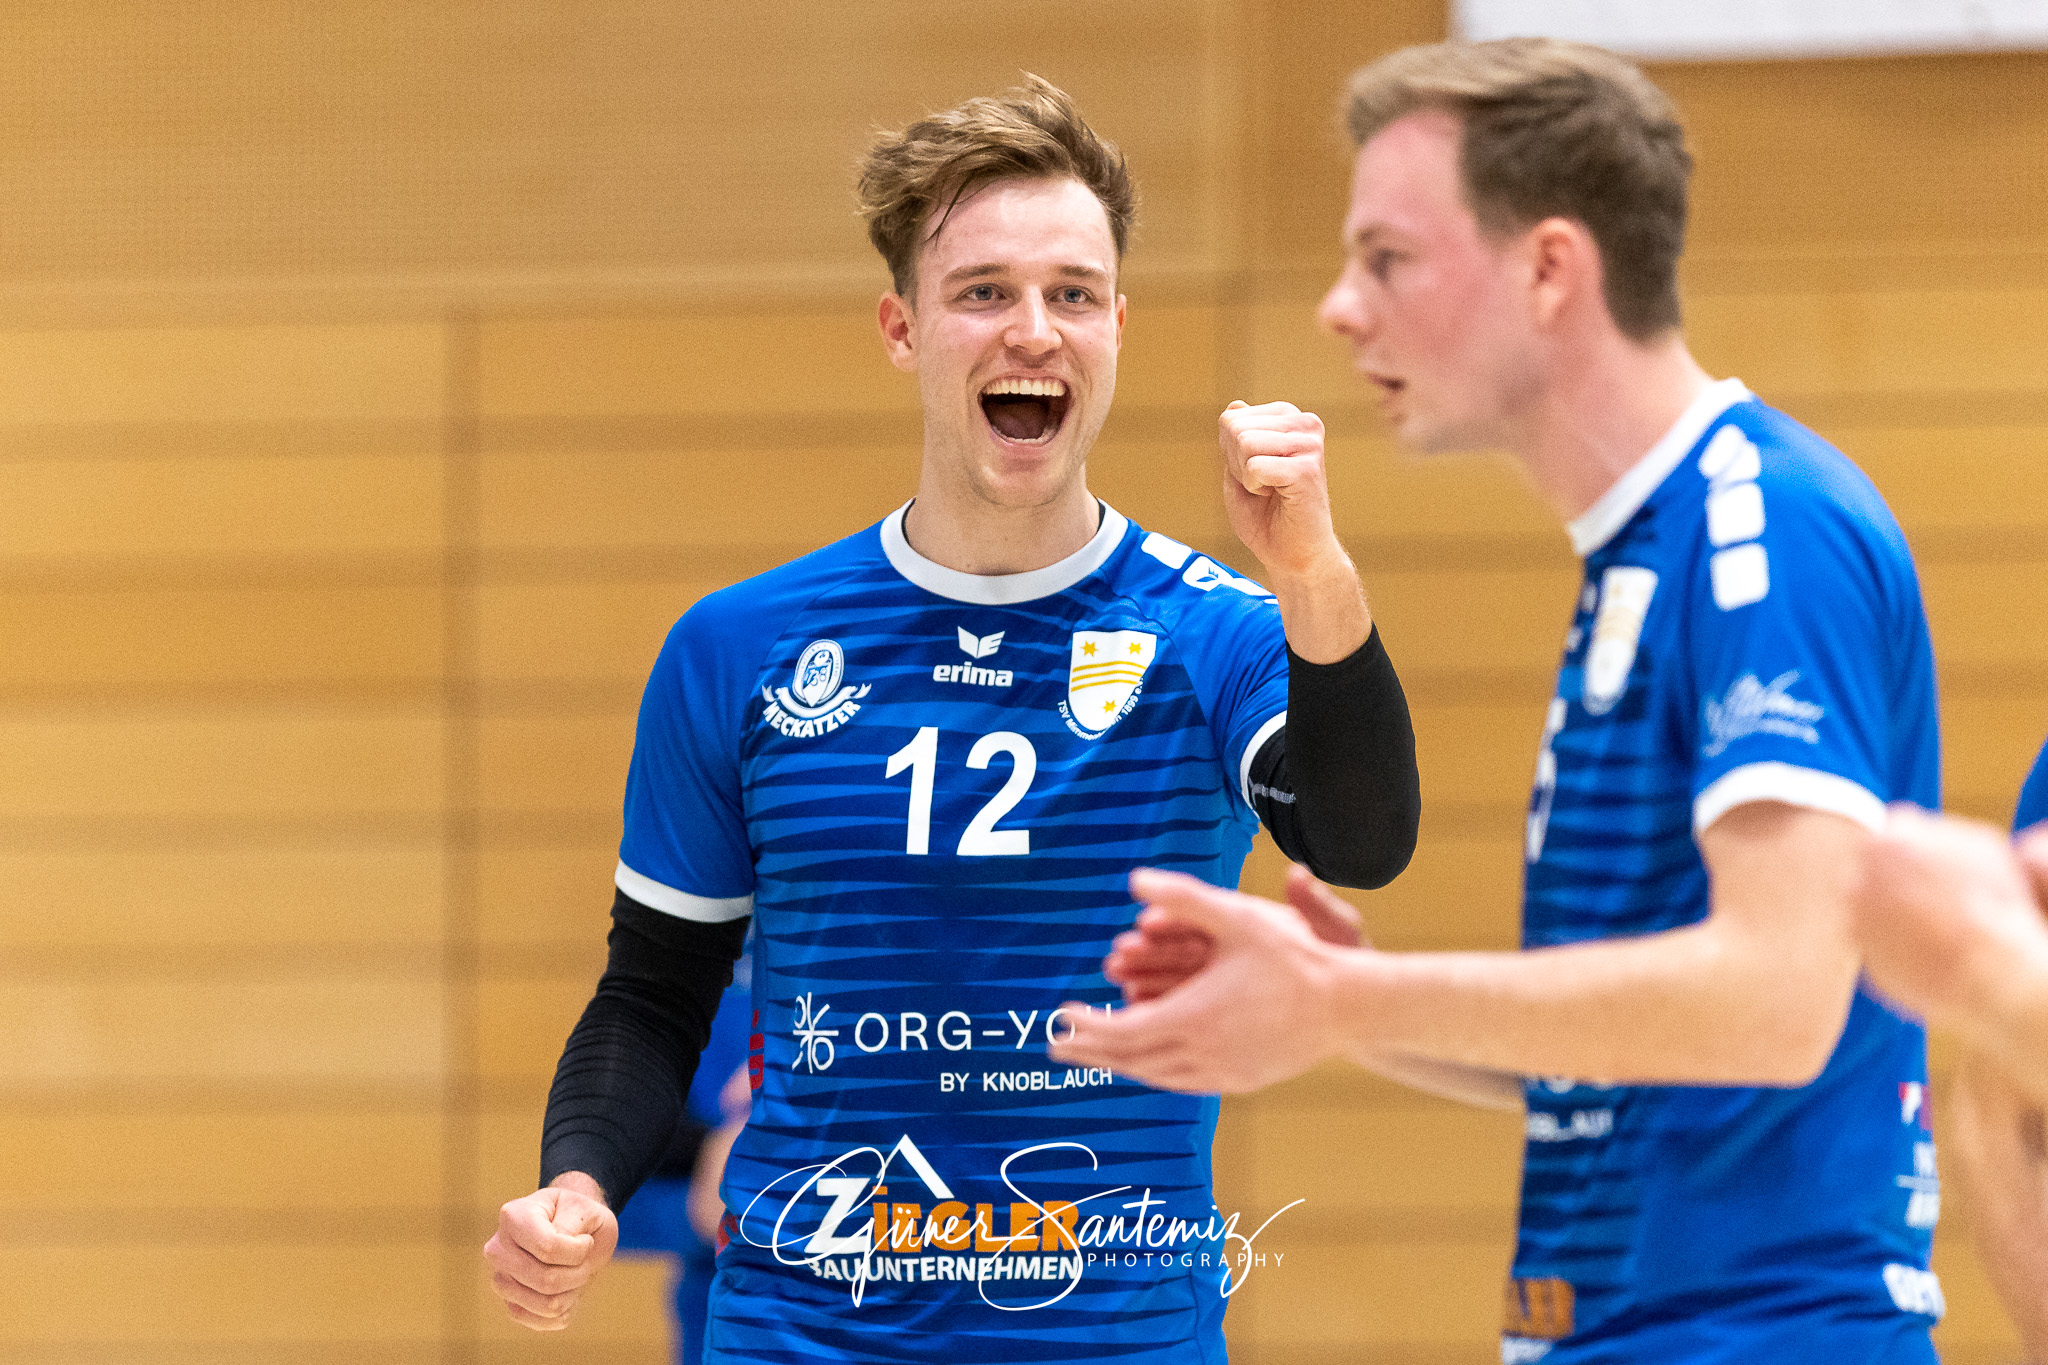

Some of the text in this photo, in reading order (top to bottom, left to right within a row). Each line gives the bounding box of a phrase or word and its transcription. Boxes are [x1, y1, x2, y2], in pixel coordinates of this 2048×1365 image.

[933, 661, 1014, 687] erima
[762, 700, 862, 738] MECKATZER
[1058, 700, 1071, 719] TSV
[1121, 695, 1139, 716] 1899
[885, 726, 1037, 856] 12
[854, 1003, 1112, 1053] ORG-YO
[940, 1067, 1113, 1092] BY KNOBLAUCH
